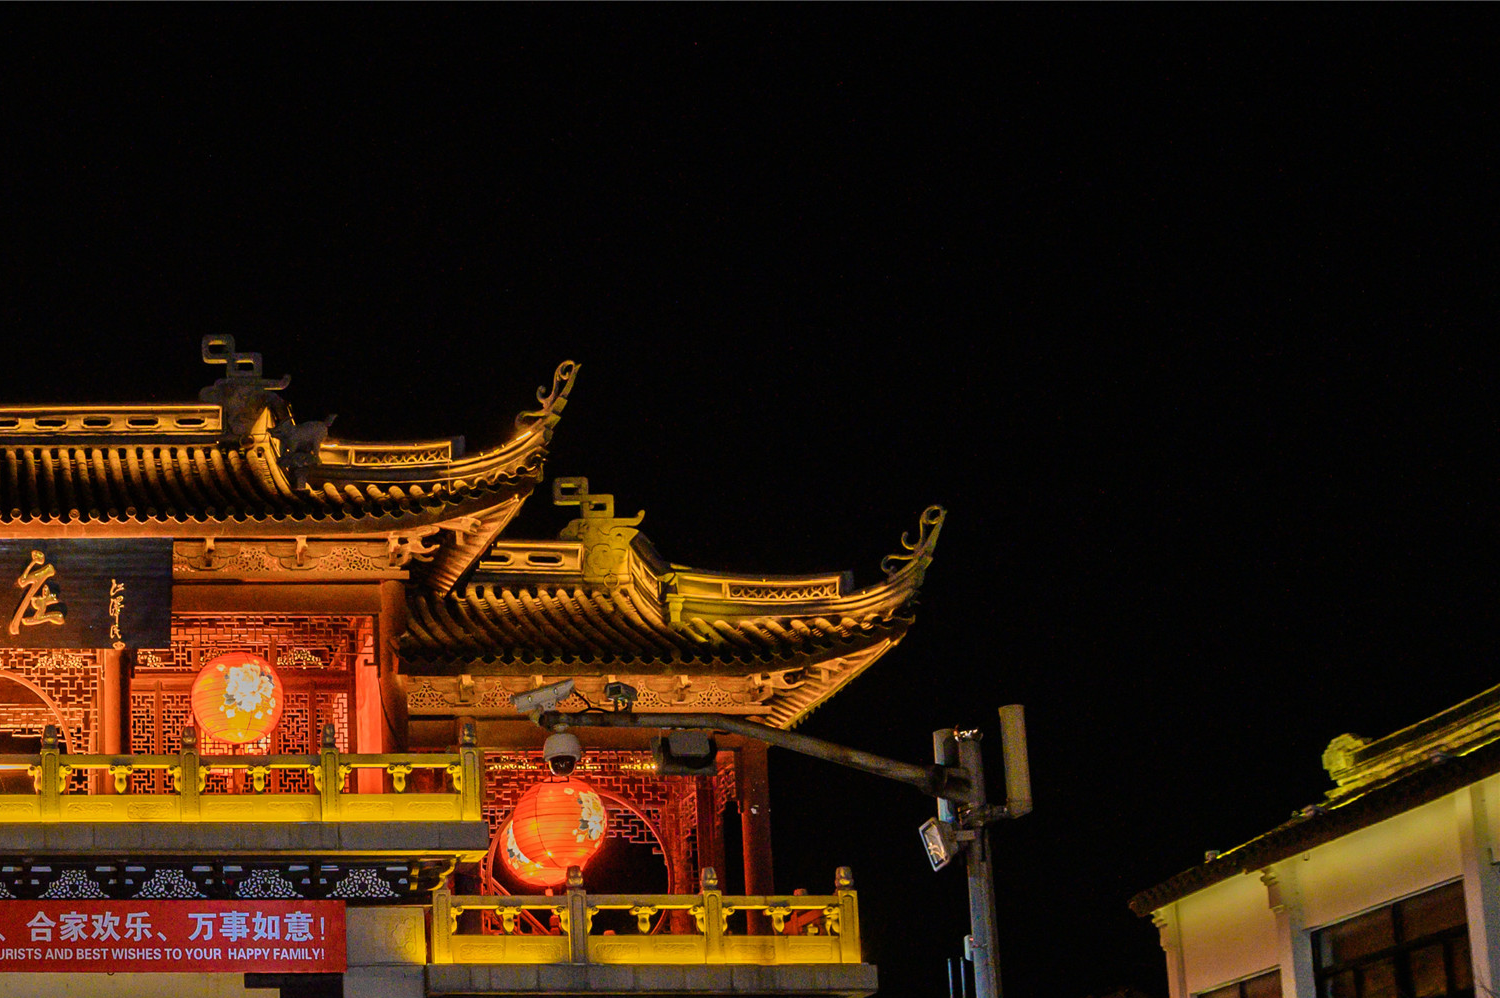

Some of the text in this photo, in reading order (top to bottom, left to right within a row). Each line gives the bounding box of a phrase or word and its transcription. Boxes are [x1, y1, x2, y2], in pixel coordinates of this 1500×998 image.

[45, 948, 73, 960] AND
[76, 948, 109, 960] BEST
[111, 948, 162, 960] WISHES
[164, 948, 182, 960] TO
[184, 948, 222, 960] YOUR
[228, 948, 270, 960] HAPPY
[273, 948, 326, 960] FAMILY!
